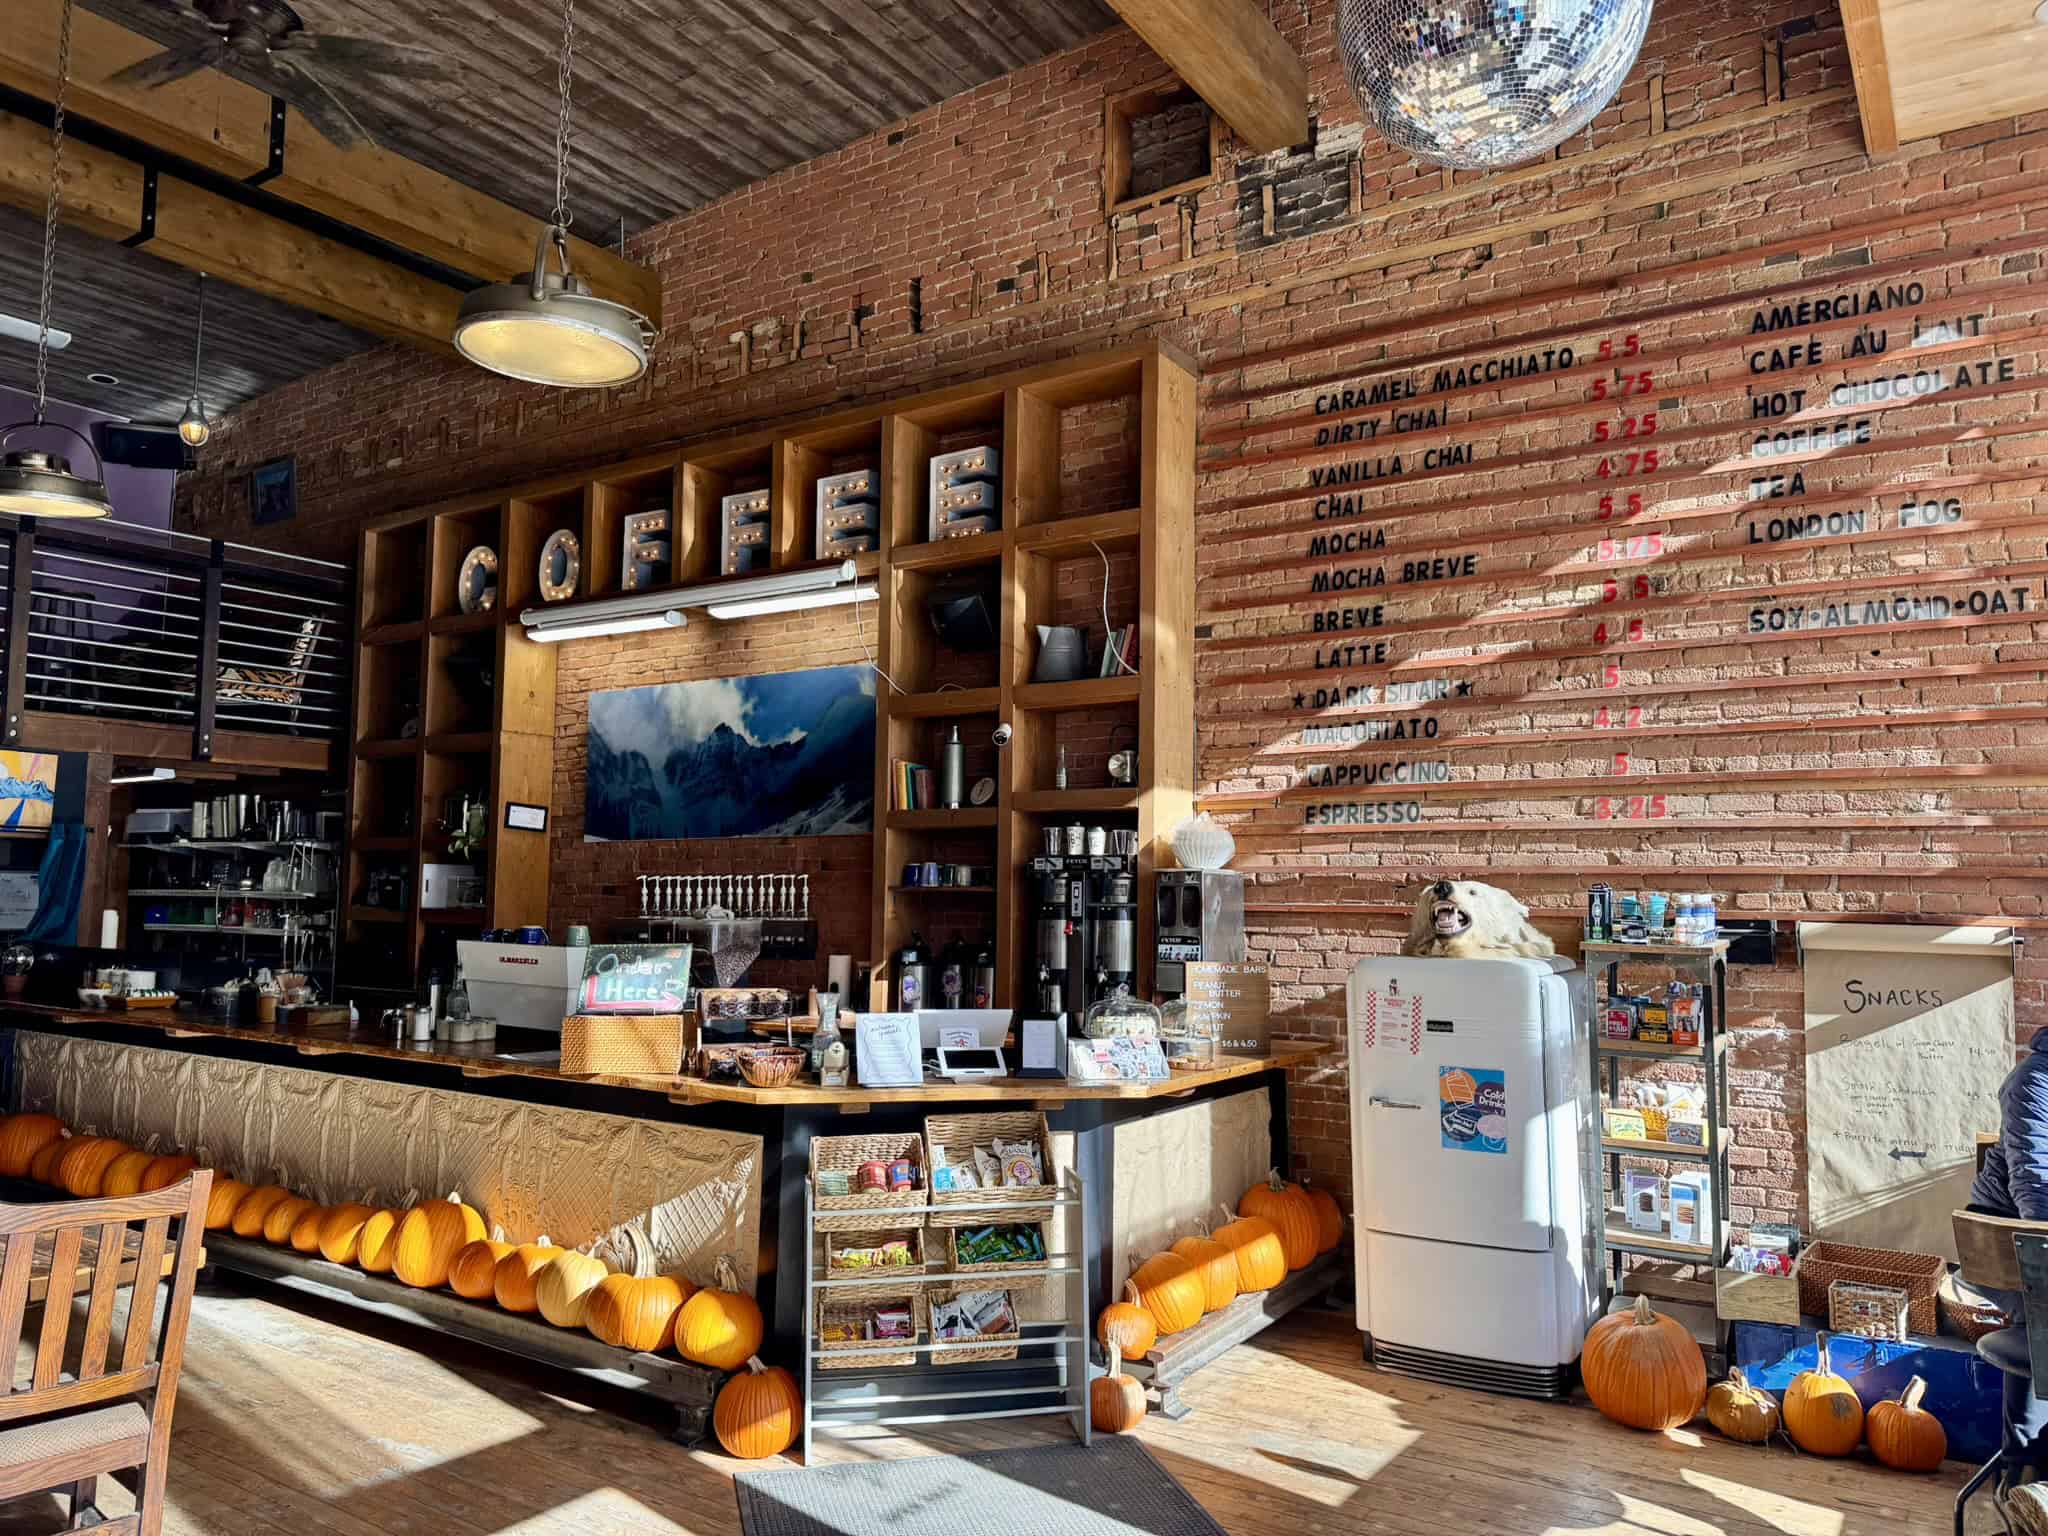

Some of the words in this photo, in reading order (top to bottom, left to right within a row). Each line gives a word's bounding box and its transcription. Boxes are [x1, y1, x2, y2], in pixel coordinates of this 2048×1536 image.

[1751, 282, 1925, 334] AMERCIANO
[1850, 330, 1887, 358] AU
[1912, 314, 1984, 347] LAIT
[1315, 382, 1416, 415] CARAMEL
[1433, 348, 1574, 391] MACCHIATO
[1752, 390, 1807, 419] HOT
[1831, 358, 2015, 407] CHOCOLATE
[1317, 419, 1380, 446] DIRTY
[1396, 406, 1447, 433] CHAI
[1752, 420, 1871, 457] COFFEE
[1311, 455, 1402, 487] VANILLA
[1425, 444, 1473, 470] CHAI
[1751, 472, 1806, 499] TEA
[1315, 496, 1363, 520] CHAI
[1750, 510, 1865, 544] LONDON
[1900, 498, 1962, 527] FOG
[1311, 529, 1386, 557] MOCHA
[1312, 566, 1386, 593] MOCHA
[1403, 555, 1475, 583] BREVE
[1314, 606, 1384, 632] BREVE
[1315, 643, 1385, 669] LATTE
[1604, 665, 1619, 688] 5
[1314, 685, 1373, 708] DARK
[1385, 680, 1448, 703] STAR
[1303, 718, 1438, 744] MACCHIATO
[1308, 760, 1448, 787] CAPPUCCINO
[1615, 753, 1629, 775] 5
[1305, 802, 1421, 824] ESPRESSO
[596, 953, 673, 976] Order
[1243, 965, 1267, 975] BARS
[606, 975, 658, 1000] Here
[1208, 989, 1241, 999] BUTTER
[1483, 1087, 1505, 1100] Cold
